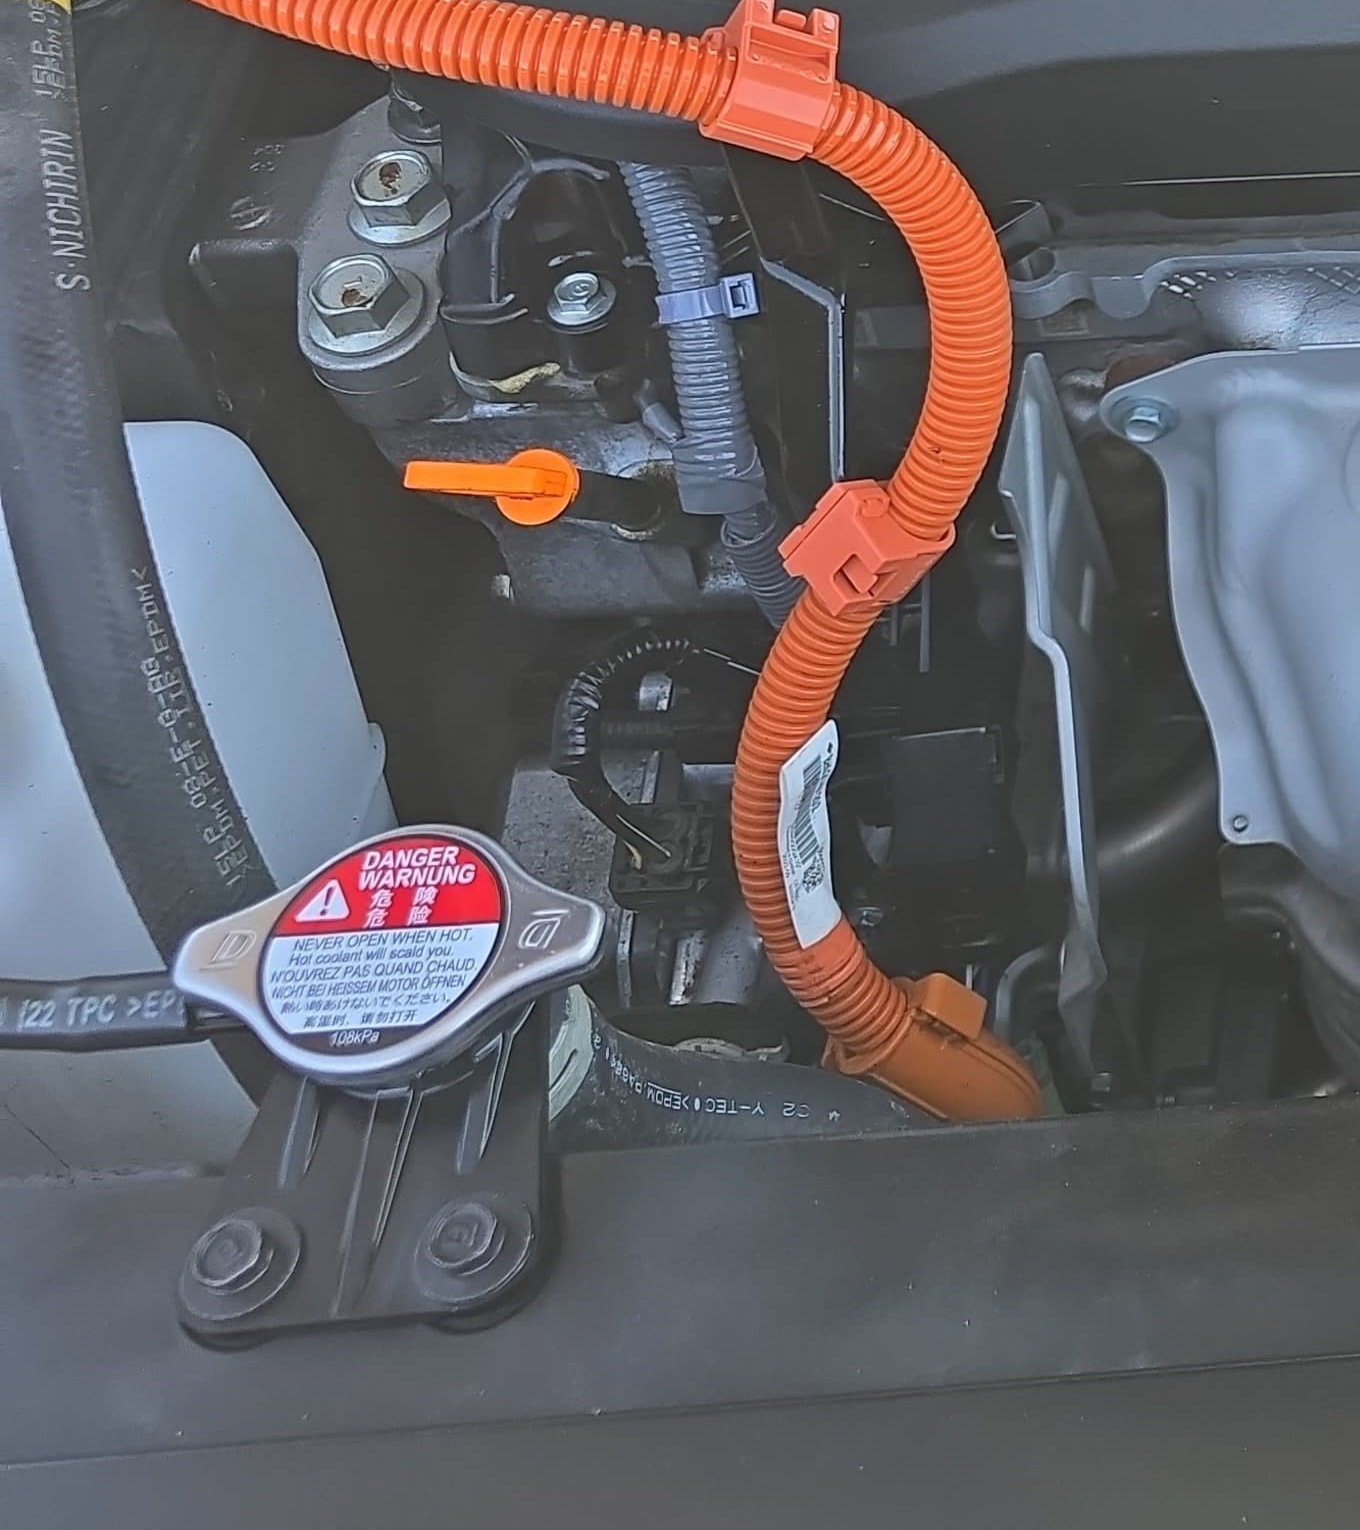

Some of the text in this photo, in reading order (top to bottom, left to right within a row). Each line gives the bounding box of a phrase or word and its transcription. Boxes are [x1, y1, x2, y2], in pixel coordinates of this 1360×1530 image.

[362, 845, 460, 870] DANGER
[358, 863, 477, 891] WARNUNG
[293, 928, 474, 951] NEVER OPEN WHEN HOT.
[288, 945, 455, 966] Hot coolant will scald you.
[270, 957, 478, 983] N'OUVREZ PAS QUAND CHAUD.
[271, 973, 467, 1000] NICHT BEI HEISSEM MOTOR ÖFFNEN
[330, 1029, 380, 1047] 108kPa
